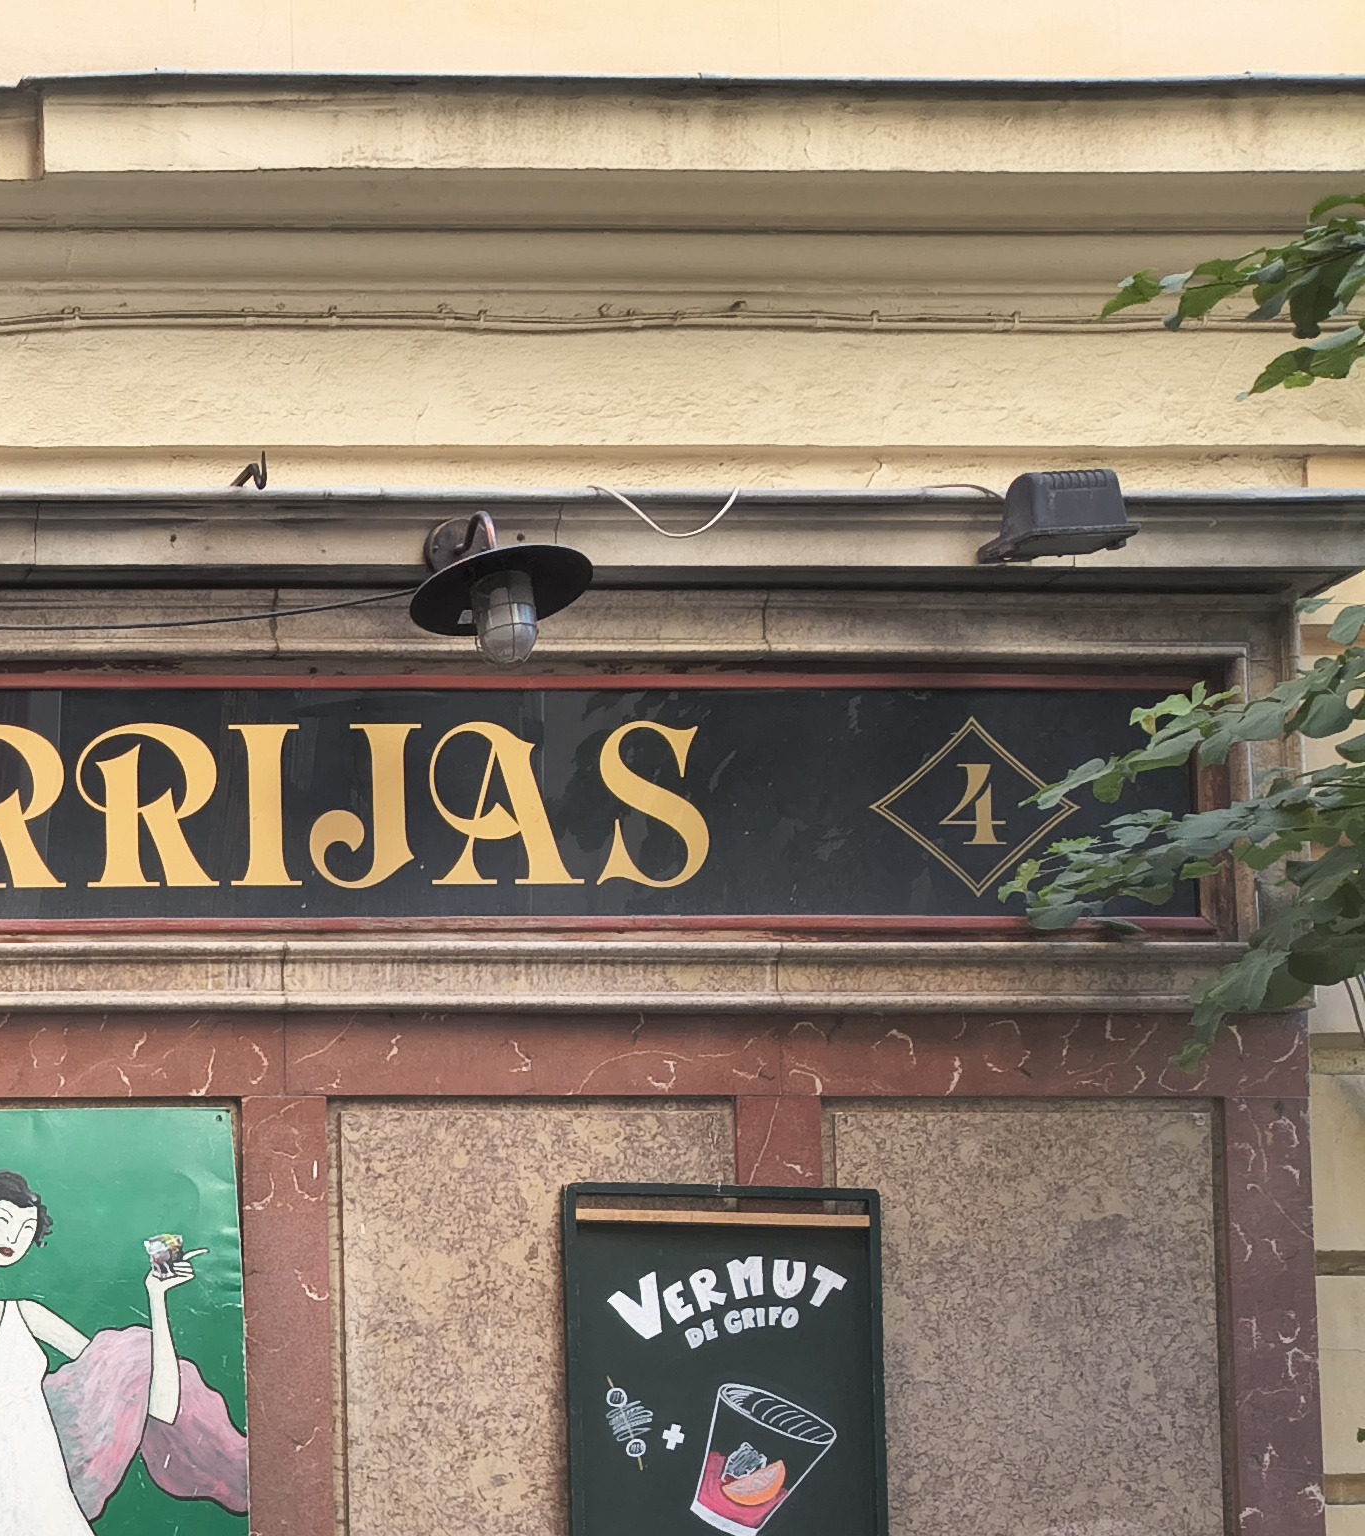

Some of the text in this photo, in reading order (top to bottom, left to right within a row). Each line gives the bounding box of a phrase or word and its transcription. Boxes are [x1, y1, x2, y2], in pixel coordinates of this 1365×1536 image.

[937, 764, 1008, 847] 4
[607, 1256, 848, 1340] VERMUT
[684, 1306, 800, 1350] DE GRIFO
